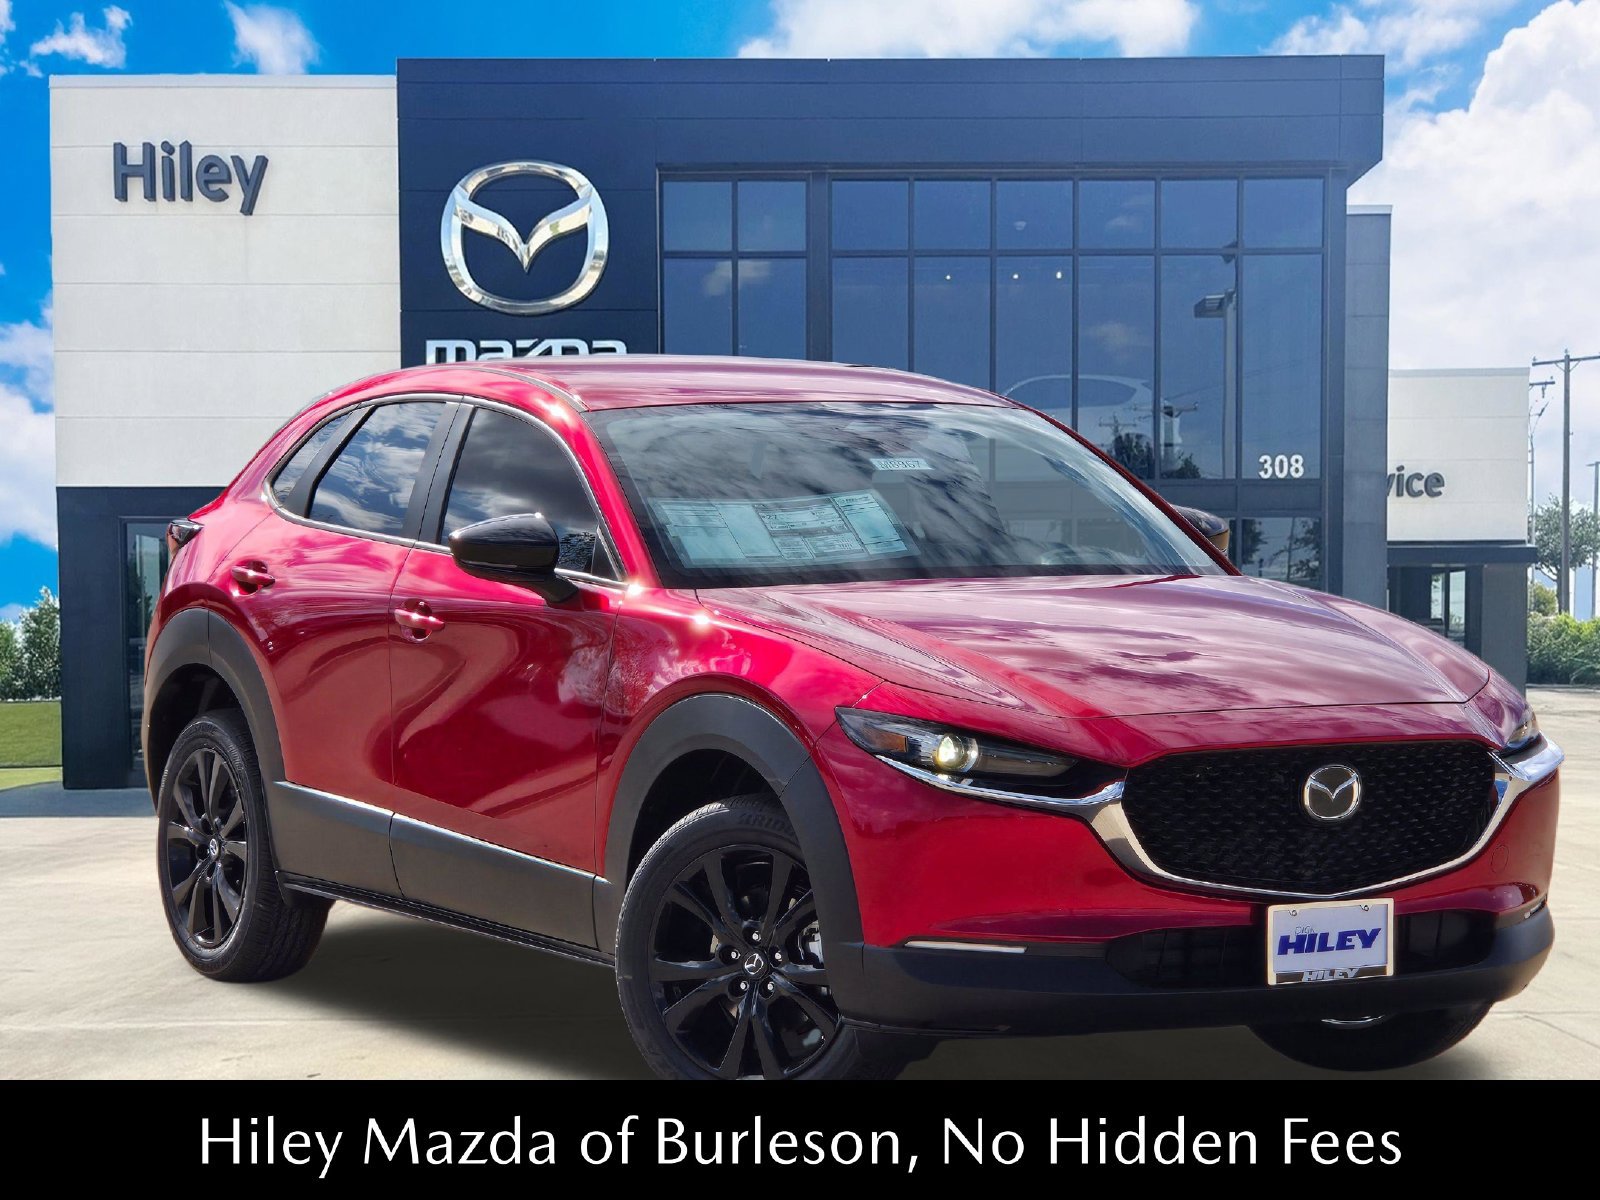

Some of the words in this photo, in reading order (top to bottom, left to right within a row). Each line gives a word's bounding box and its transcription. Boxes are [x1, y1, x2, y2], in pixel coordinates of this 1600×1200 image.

[113, 140, 269, 216] Hiley
[1259, 454, 1304, 479] 308
[1277, 928, 1381, 955] HILEY
[1302, 968, 1360, 982] HILEY
